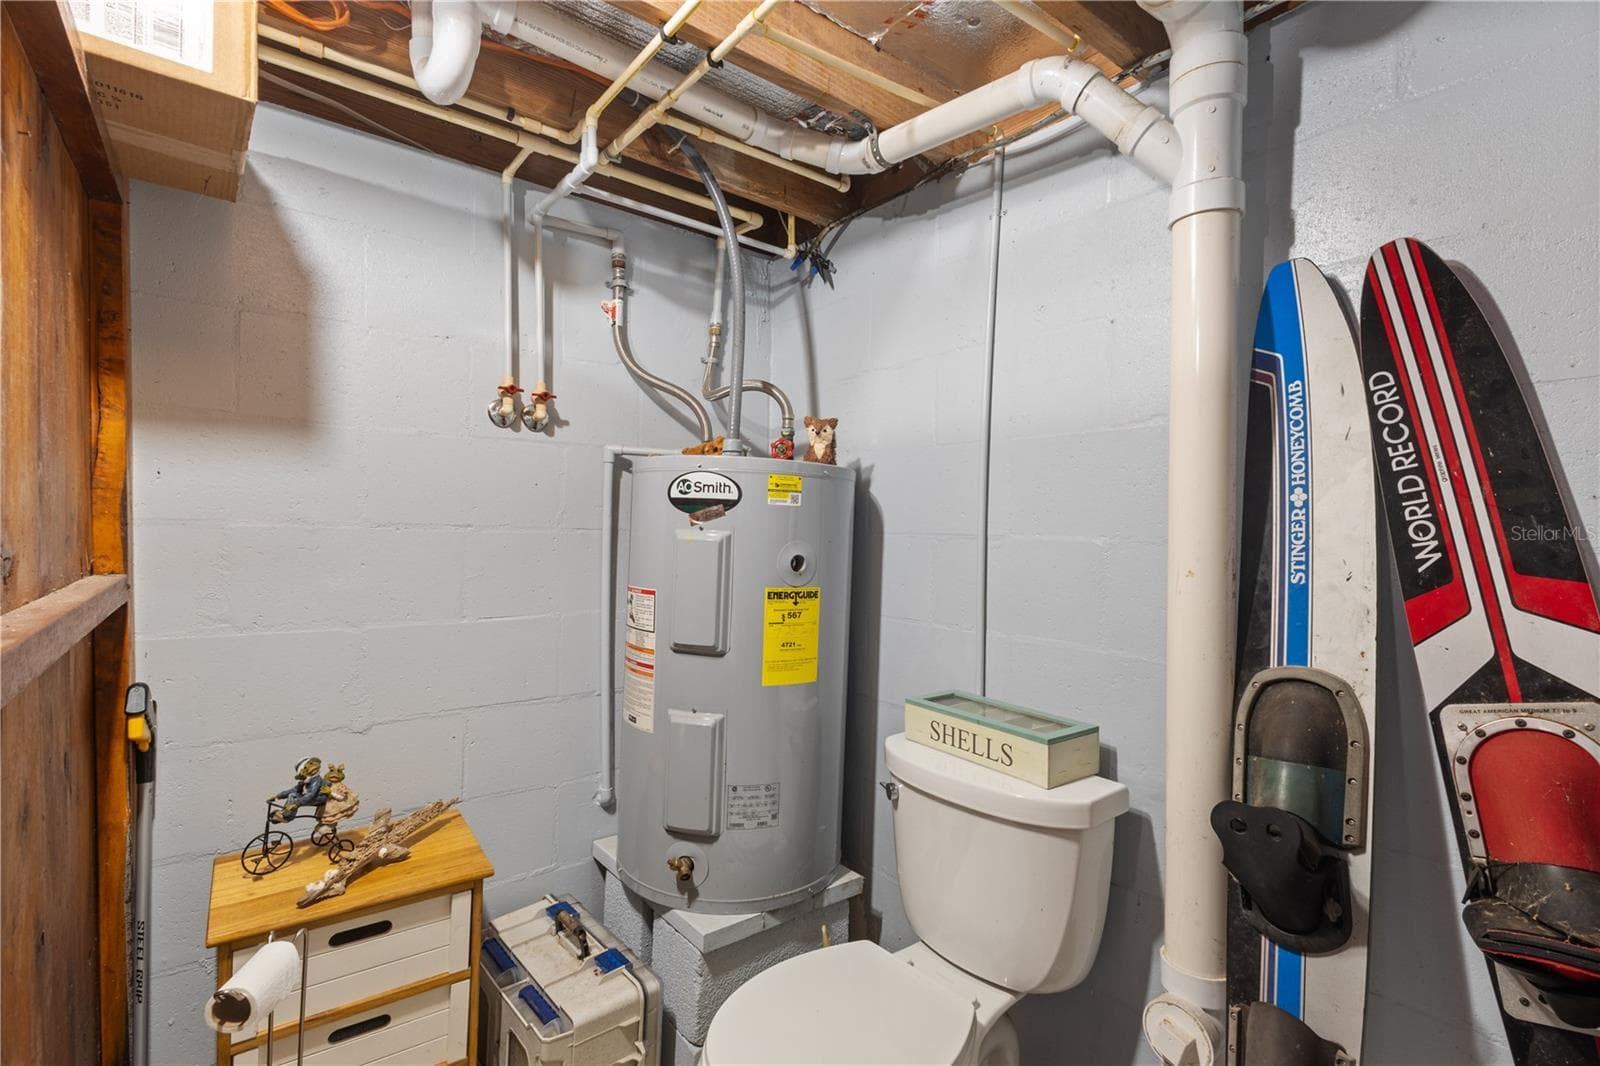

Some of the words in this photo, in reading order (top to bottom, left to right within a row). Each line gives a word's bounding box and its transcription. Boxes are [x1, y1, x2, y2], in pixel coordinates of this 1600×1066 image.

[1288, 380, 1306, 486] HONEYCOMB
[1368, 371, 1419, 472] RECORD
[694, 481, 731, 494] Smith
[1397, 474, 1443, 574] WORLD
[1290, 508, 1306, 585] STINGER
[767, 591, 819, 602] ENERGYGUIDE
[930, 720, 1013, 767] SHELLS
